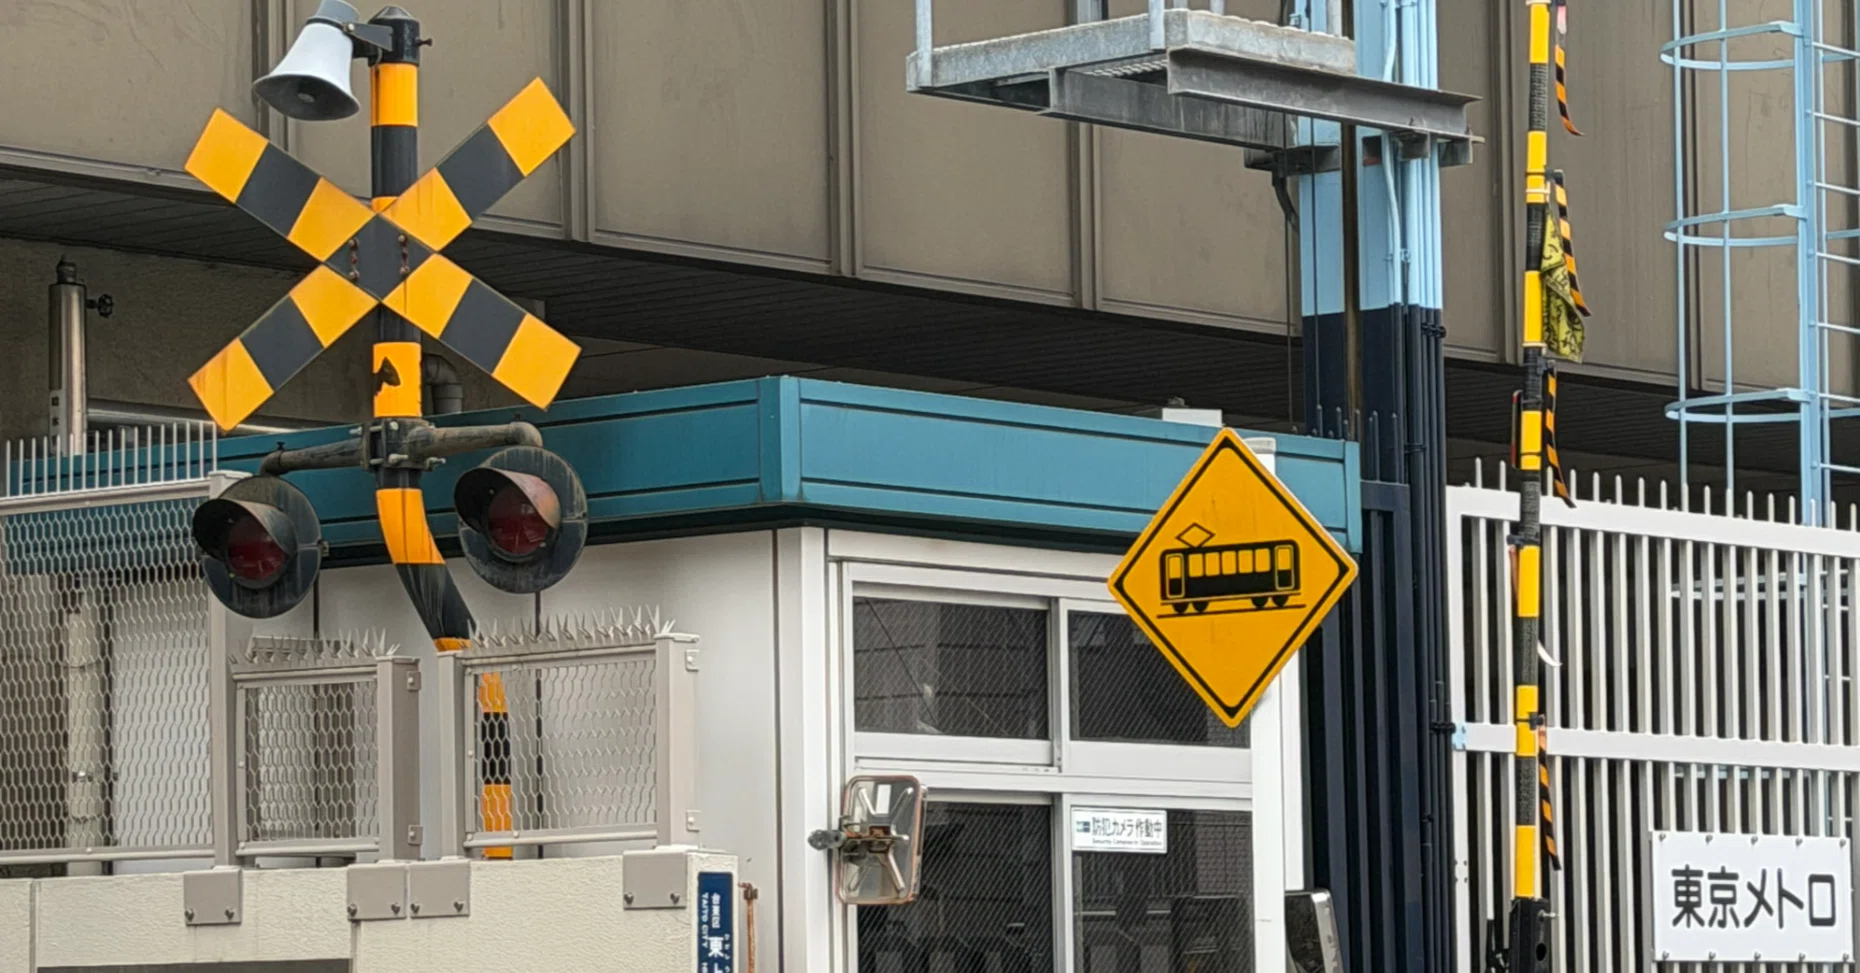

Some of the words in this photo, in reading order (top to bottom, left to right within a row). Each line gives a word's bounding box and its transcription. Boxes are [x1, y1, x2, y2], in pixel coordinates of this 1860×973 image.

[1092, 816, 1162, 838] 防犯カメラ作動中
[701, 892, 709, 922] TAITO
[1671, 864, 1836, 929] 東京メトロ
[701, 924, 709, 948] CITY
